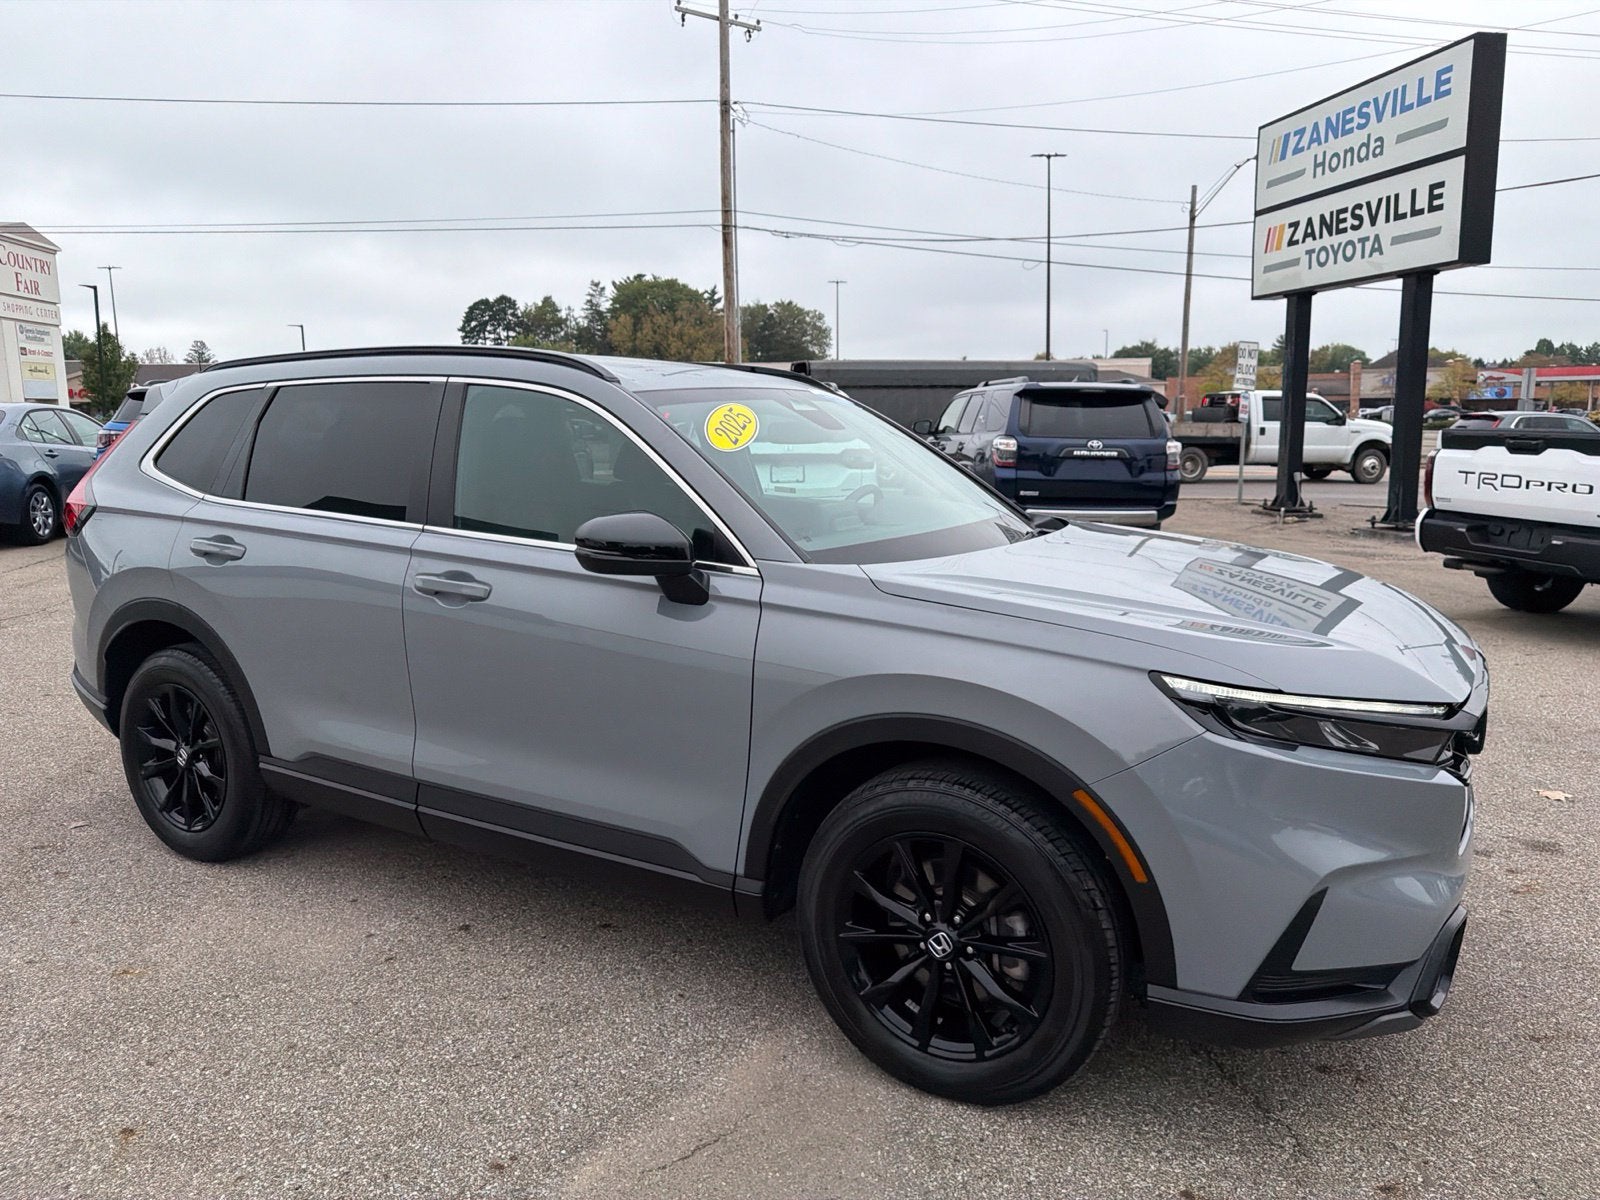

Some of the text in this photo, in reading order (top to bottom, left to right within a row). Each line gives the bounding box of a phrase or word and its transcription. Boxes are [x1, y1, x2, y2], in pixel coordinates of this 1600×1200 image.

[1290, 64, 1454, 157] ZANESVILLE
[1312, 132, 1385, 179] Honda
[1286, 180, 1446, 248] ZANESVILLE
[1304, 233, 1385, 270] TOYOTA
[14, 271, 42, 296] FAIR
[2, 301, 58, 320] SHOPPING CENTER
[1237, 363, 1256, 376] BLOCK
[1238, 347, 1257, 360] DO NOT
[714, 407, 752, 446] 2025
